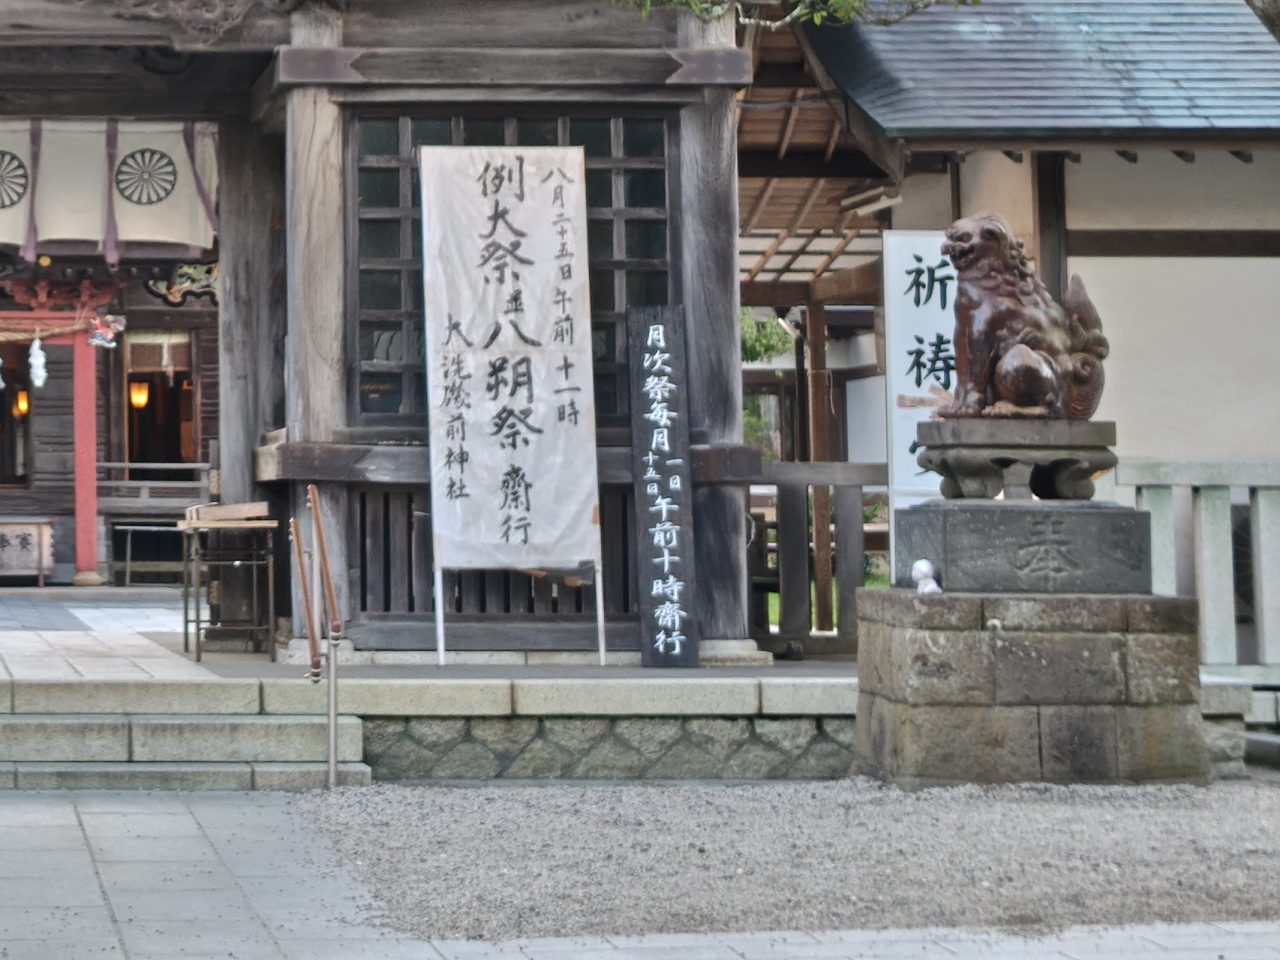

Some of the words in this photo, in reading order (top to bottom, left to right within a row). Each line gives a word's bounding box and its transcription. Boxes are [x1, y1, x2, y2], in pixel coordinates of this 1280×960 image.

[540, 167, 582, 426] 八月二十五日午前十一時
